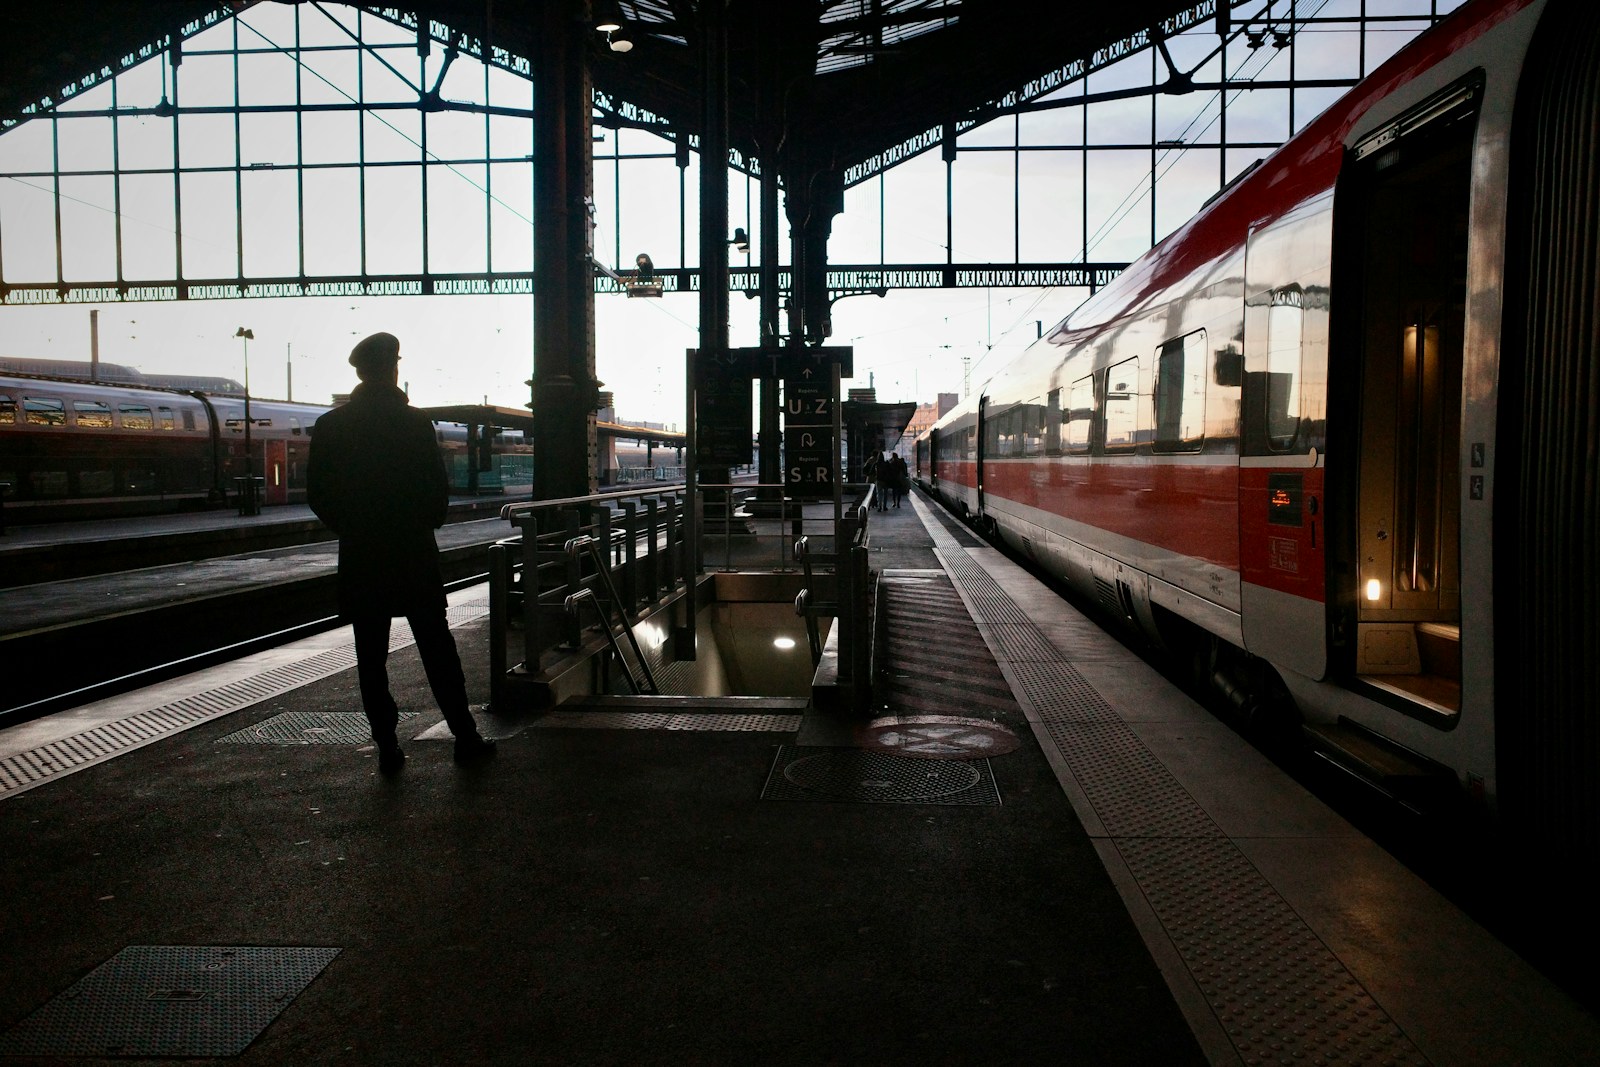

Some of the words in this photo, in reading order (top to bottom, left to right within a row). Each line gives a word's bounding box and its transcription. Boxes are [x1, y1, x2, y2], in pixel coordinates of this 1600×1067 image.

[788, 398, 802, 415] U
[815, 398, 828, 414] Z
[790, 467, 802, 483] S
[816, 466, 828, 482] R
